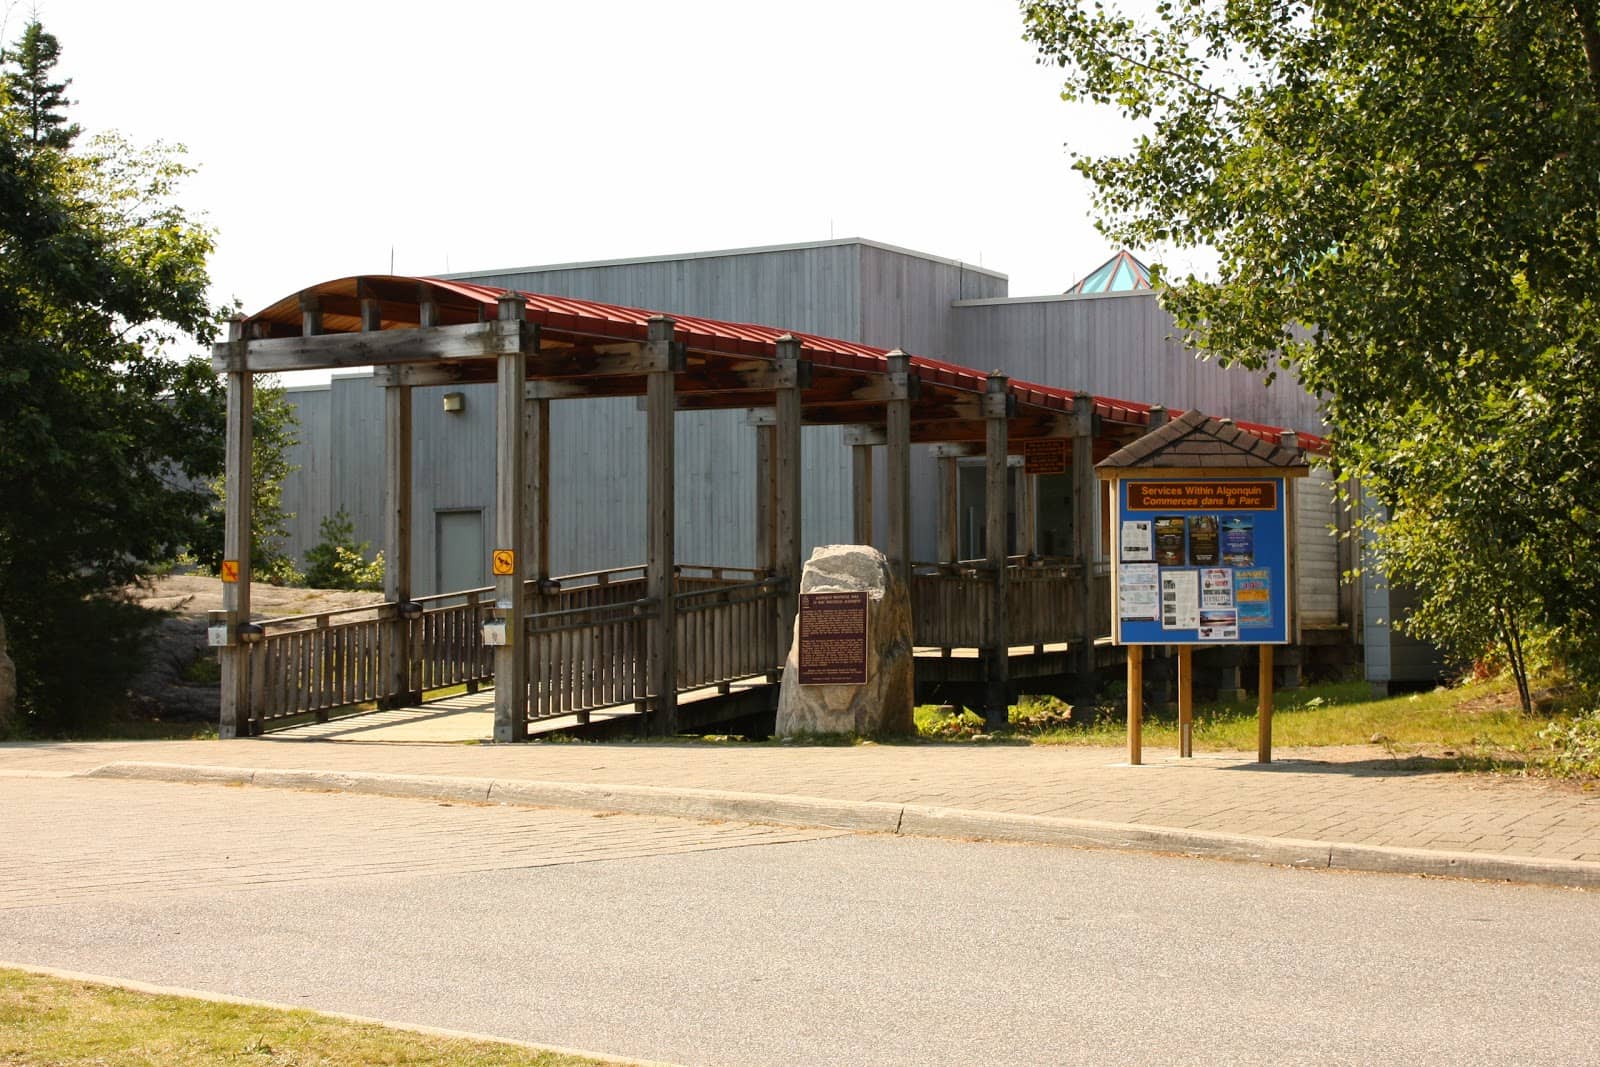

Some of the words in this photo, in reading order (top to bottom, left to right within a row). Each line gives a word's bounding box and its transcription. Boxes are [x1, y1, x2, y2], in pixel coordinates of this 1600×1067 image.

[1142, 486, 1182, 495] Services
[1185, 486, 1214, 495] Within
[1216, 486, 1262, 497] Algonquin
[1143, 497, 1198, 505] Commerces
[1201, 496, 1224, 505] dans
[1227, 496, 1236, 505] le
[1239, 496, 1260, 505] Parc
